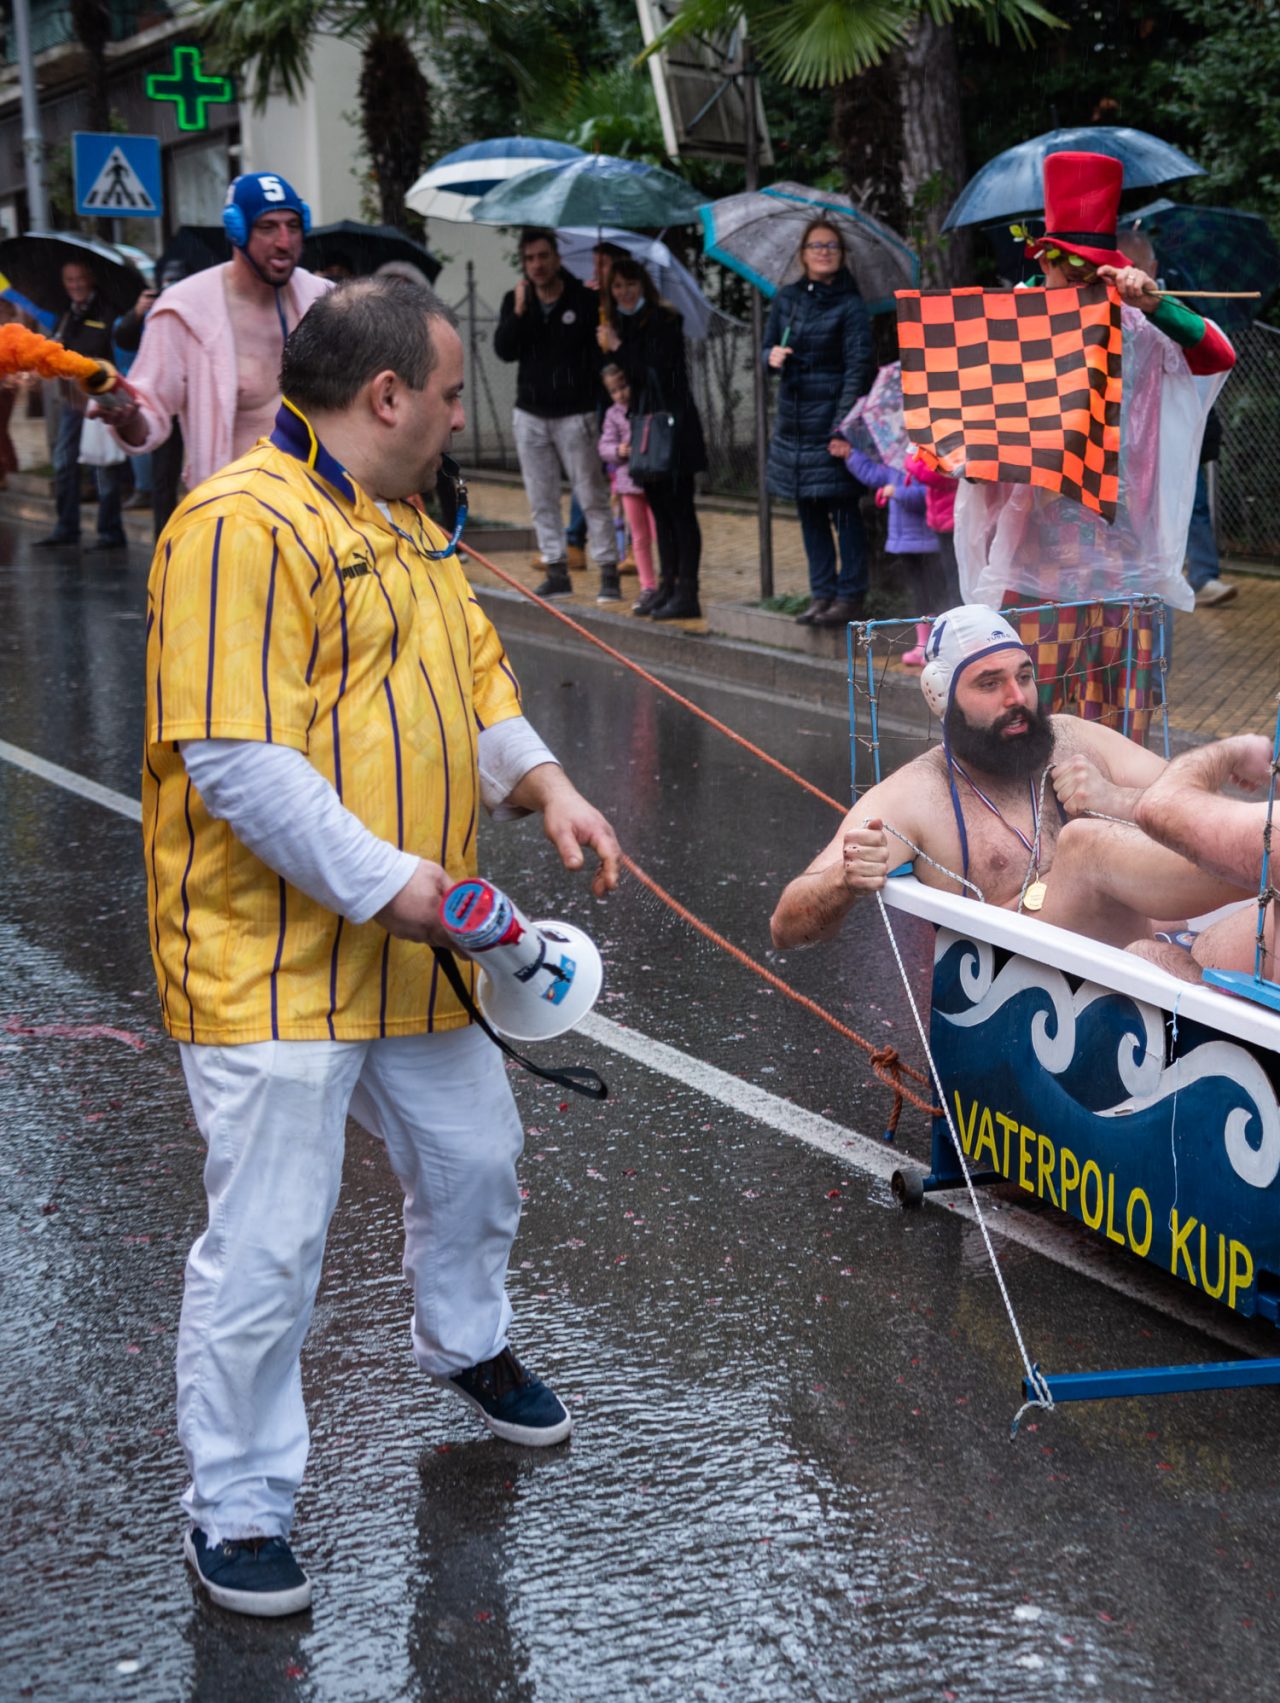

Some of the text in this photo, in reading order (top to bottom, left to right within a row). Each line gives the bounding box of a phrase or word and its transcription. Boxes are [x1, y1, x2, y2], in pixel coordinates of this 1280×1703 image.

[258, 176, 286, 202] 5
[954, 1089, 1254, 1310] VATERPOLO KUP
